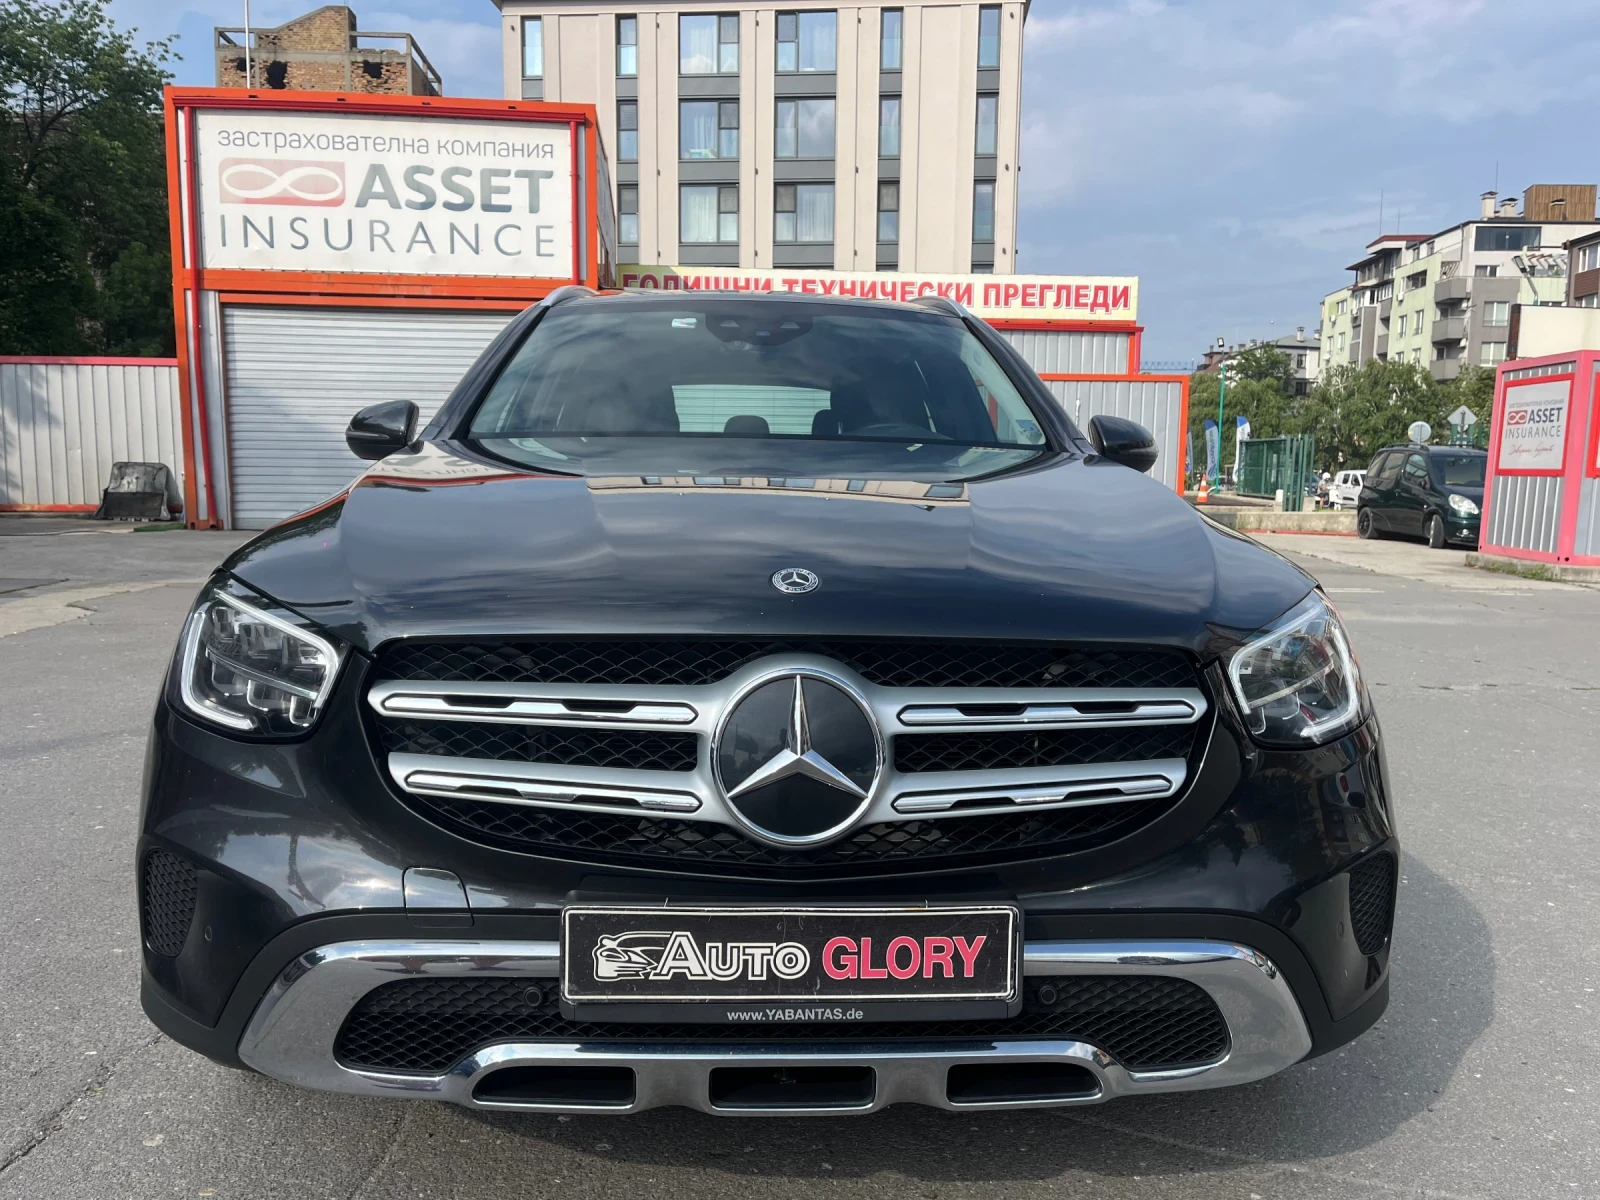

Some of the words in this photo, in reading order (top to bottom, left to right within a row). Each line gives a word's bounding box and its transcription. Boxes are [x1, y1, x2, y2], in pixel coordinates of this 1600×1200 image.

[218, 129, 429, 155] застрахователна
[437, 139, 554, 159] компания
[354, 163, 554, 214] ASSET
[219, 213, 555, 257] INSURANCE
[983, 283, 1130, 313] ПРЕГЛЕДИ
[1527, 407, 1563, 425] ASSET
[1505, 425, 1561, 440] INSURANCE
[822, 936, 987, 980] GLORY
[727, 1008, 864, 1021] www.YABANTAS.de
